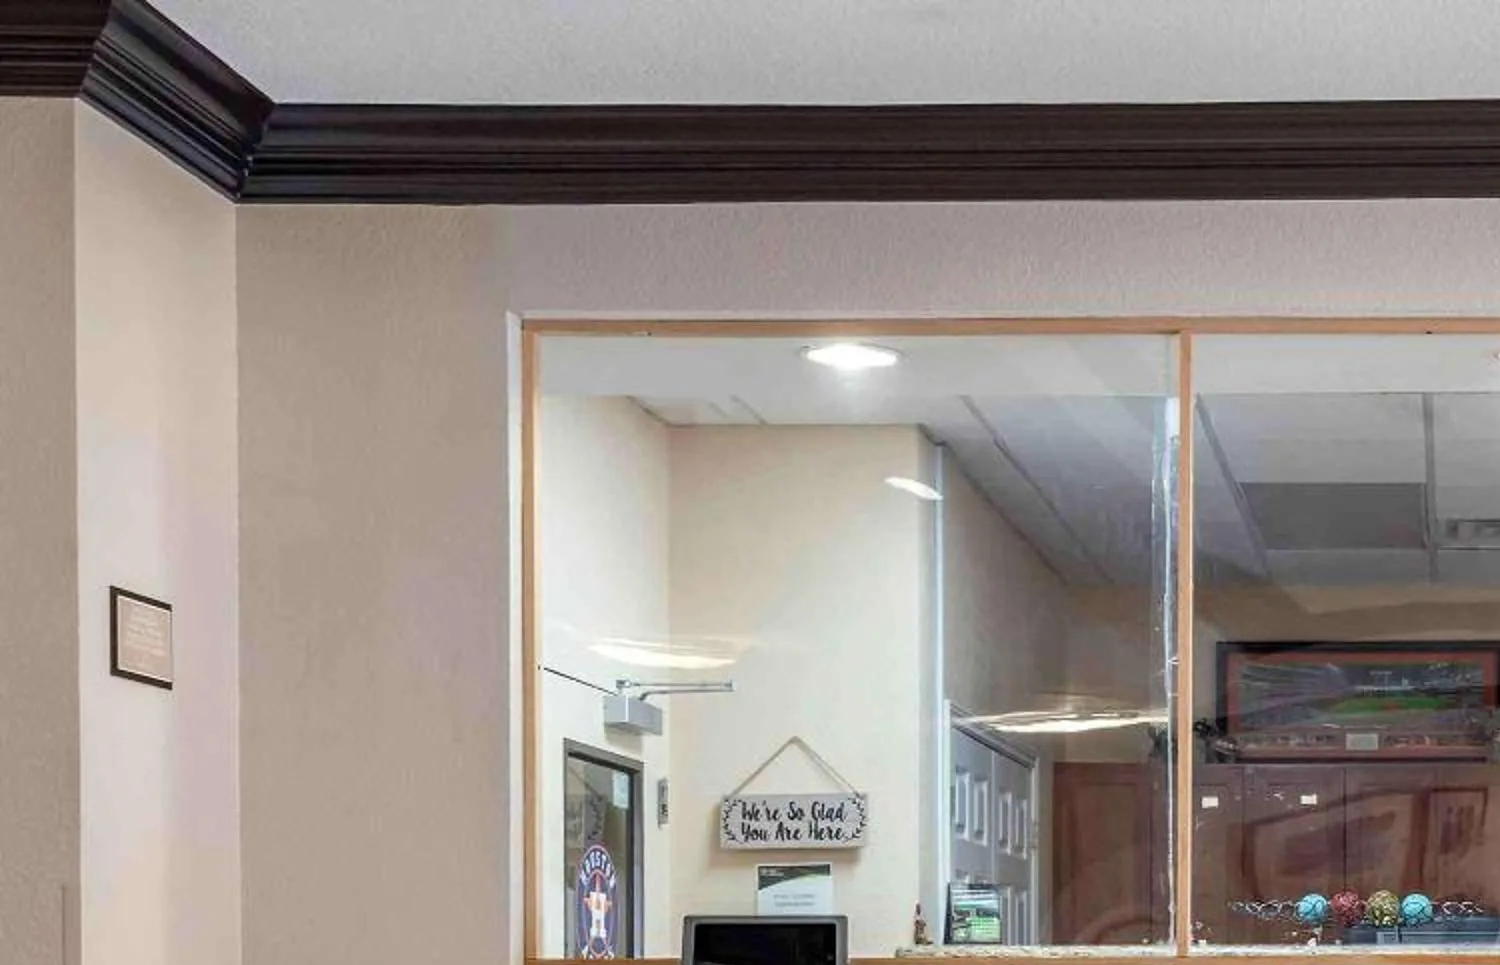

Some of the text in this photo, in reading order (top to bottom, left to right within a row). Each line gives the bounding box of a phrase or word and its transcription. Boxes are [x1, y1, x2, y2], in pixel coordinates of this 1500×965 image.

[741, 800, 848, 822] We're So Glad
[741, 820, 848, 842] You Are Here
